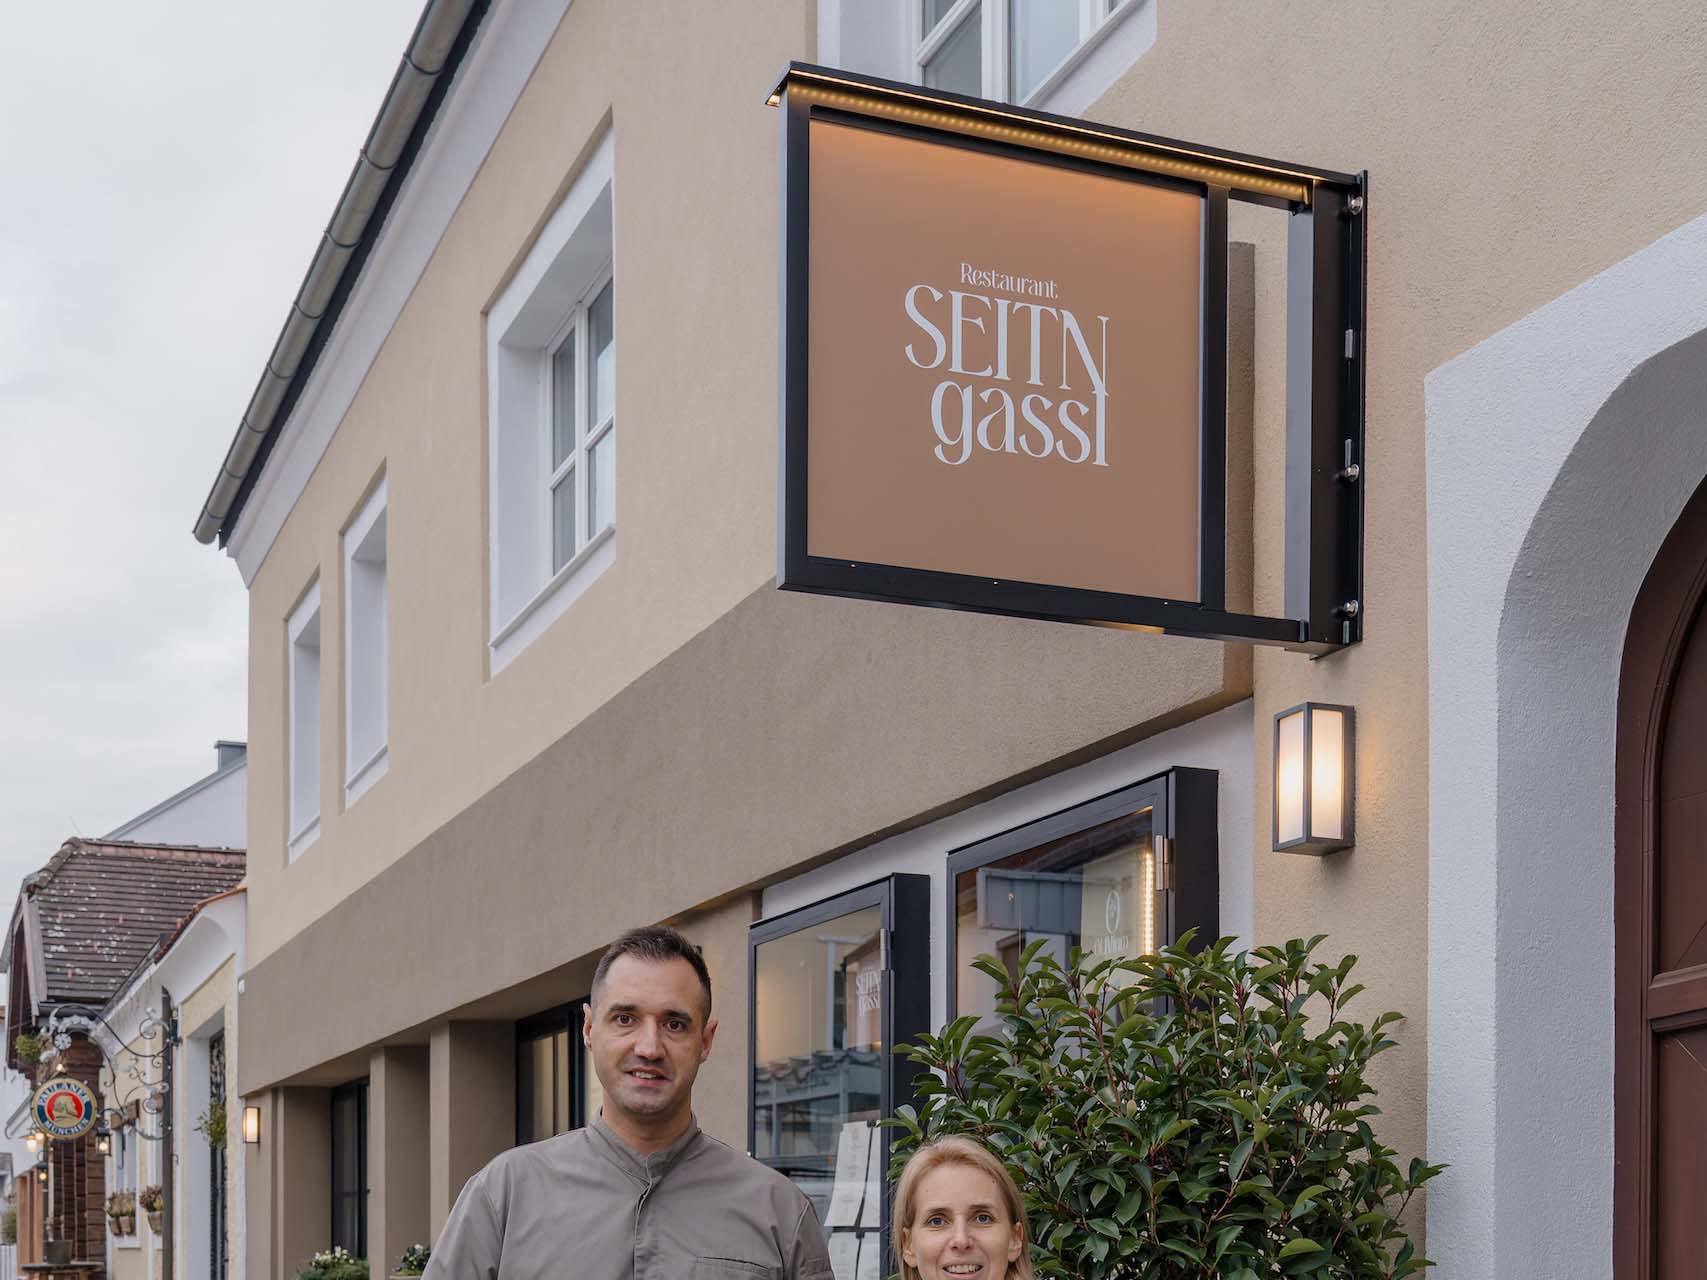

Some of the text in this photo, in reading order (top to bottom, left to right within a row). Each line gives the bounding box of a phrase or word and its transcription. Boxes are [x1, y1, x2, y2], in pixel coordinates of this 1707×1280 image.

[960, 262, 1059, 299] Restaurant
[905, 284, 1110, 396] SEITN
[931, 380, 1110, 467] gassl
[38, 1082, 90, 1105] PAULANER
